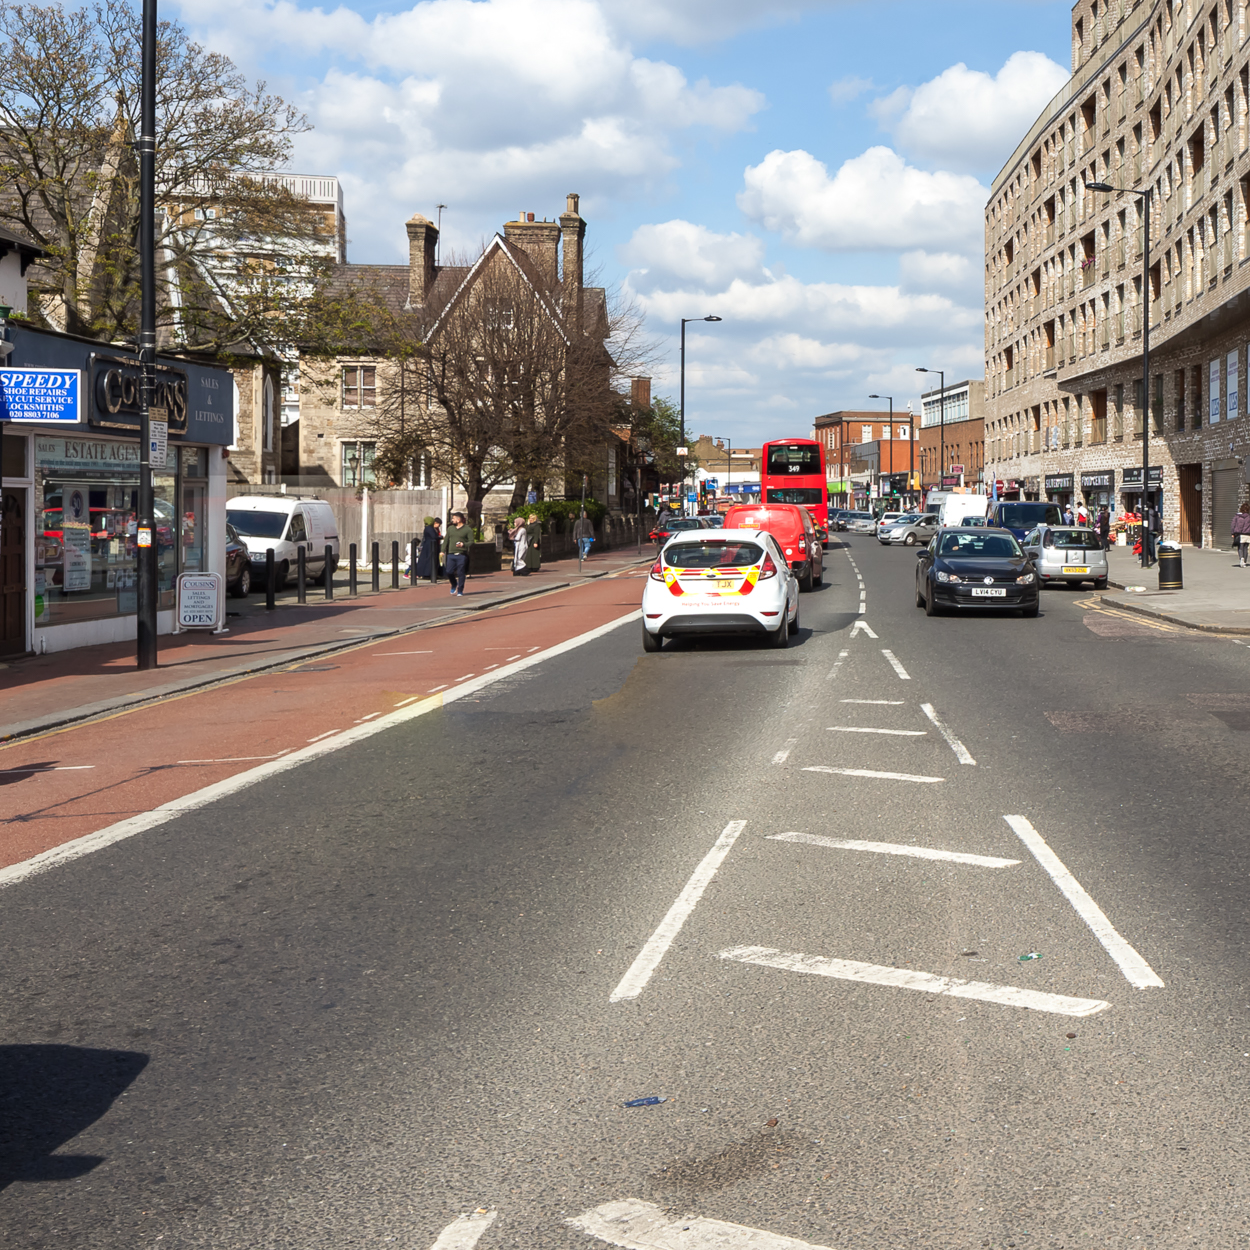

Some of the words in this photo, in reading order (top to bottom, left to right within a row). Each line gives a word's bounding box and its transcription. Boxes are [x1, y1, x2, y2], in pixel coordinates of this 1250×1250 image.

[0, 373, 76, 389] SPEEDY
[201, 377, 219, 390] SALES
[3, 387, 28, 395] SHOE
[35, 396, 73, 404] SERVICE
[206, 395, 212, 405] &
[6, 403, 65, 411] LOCKSMITHS
[195, 410, 224, 423] LETTINGS
[38, 443, 55, 452] SALES
[64, 440, 106, 460] ESTATE
[184, 581, 215, 589] COUSINS
[183, 614, 213, 622] OPEN
